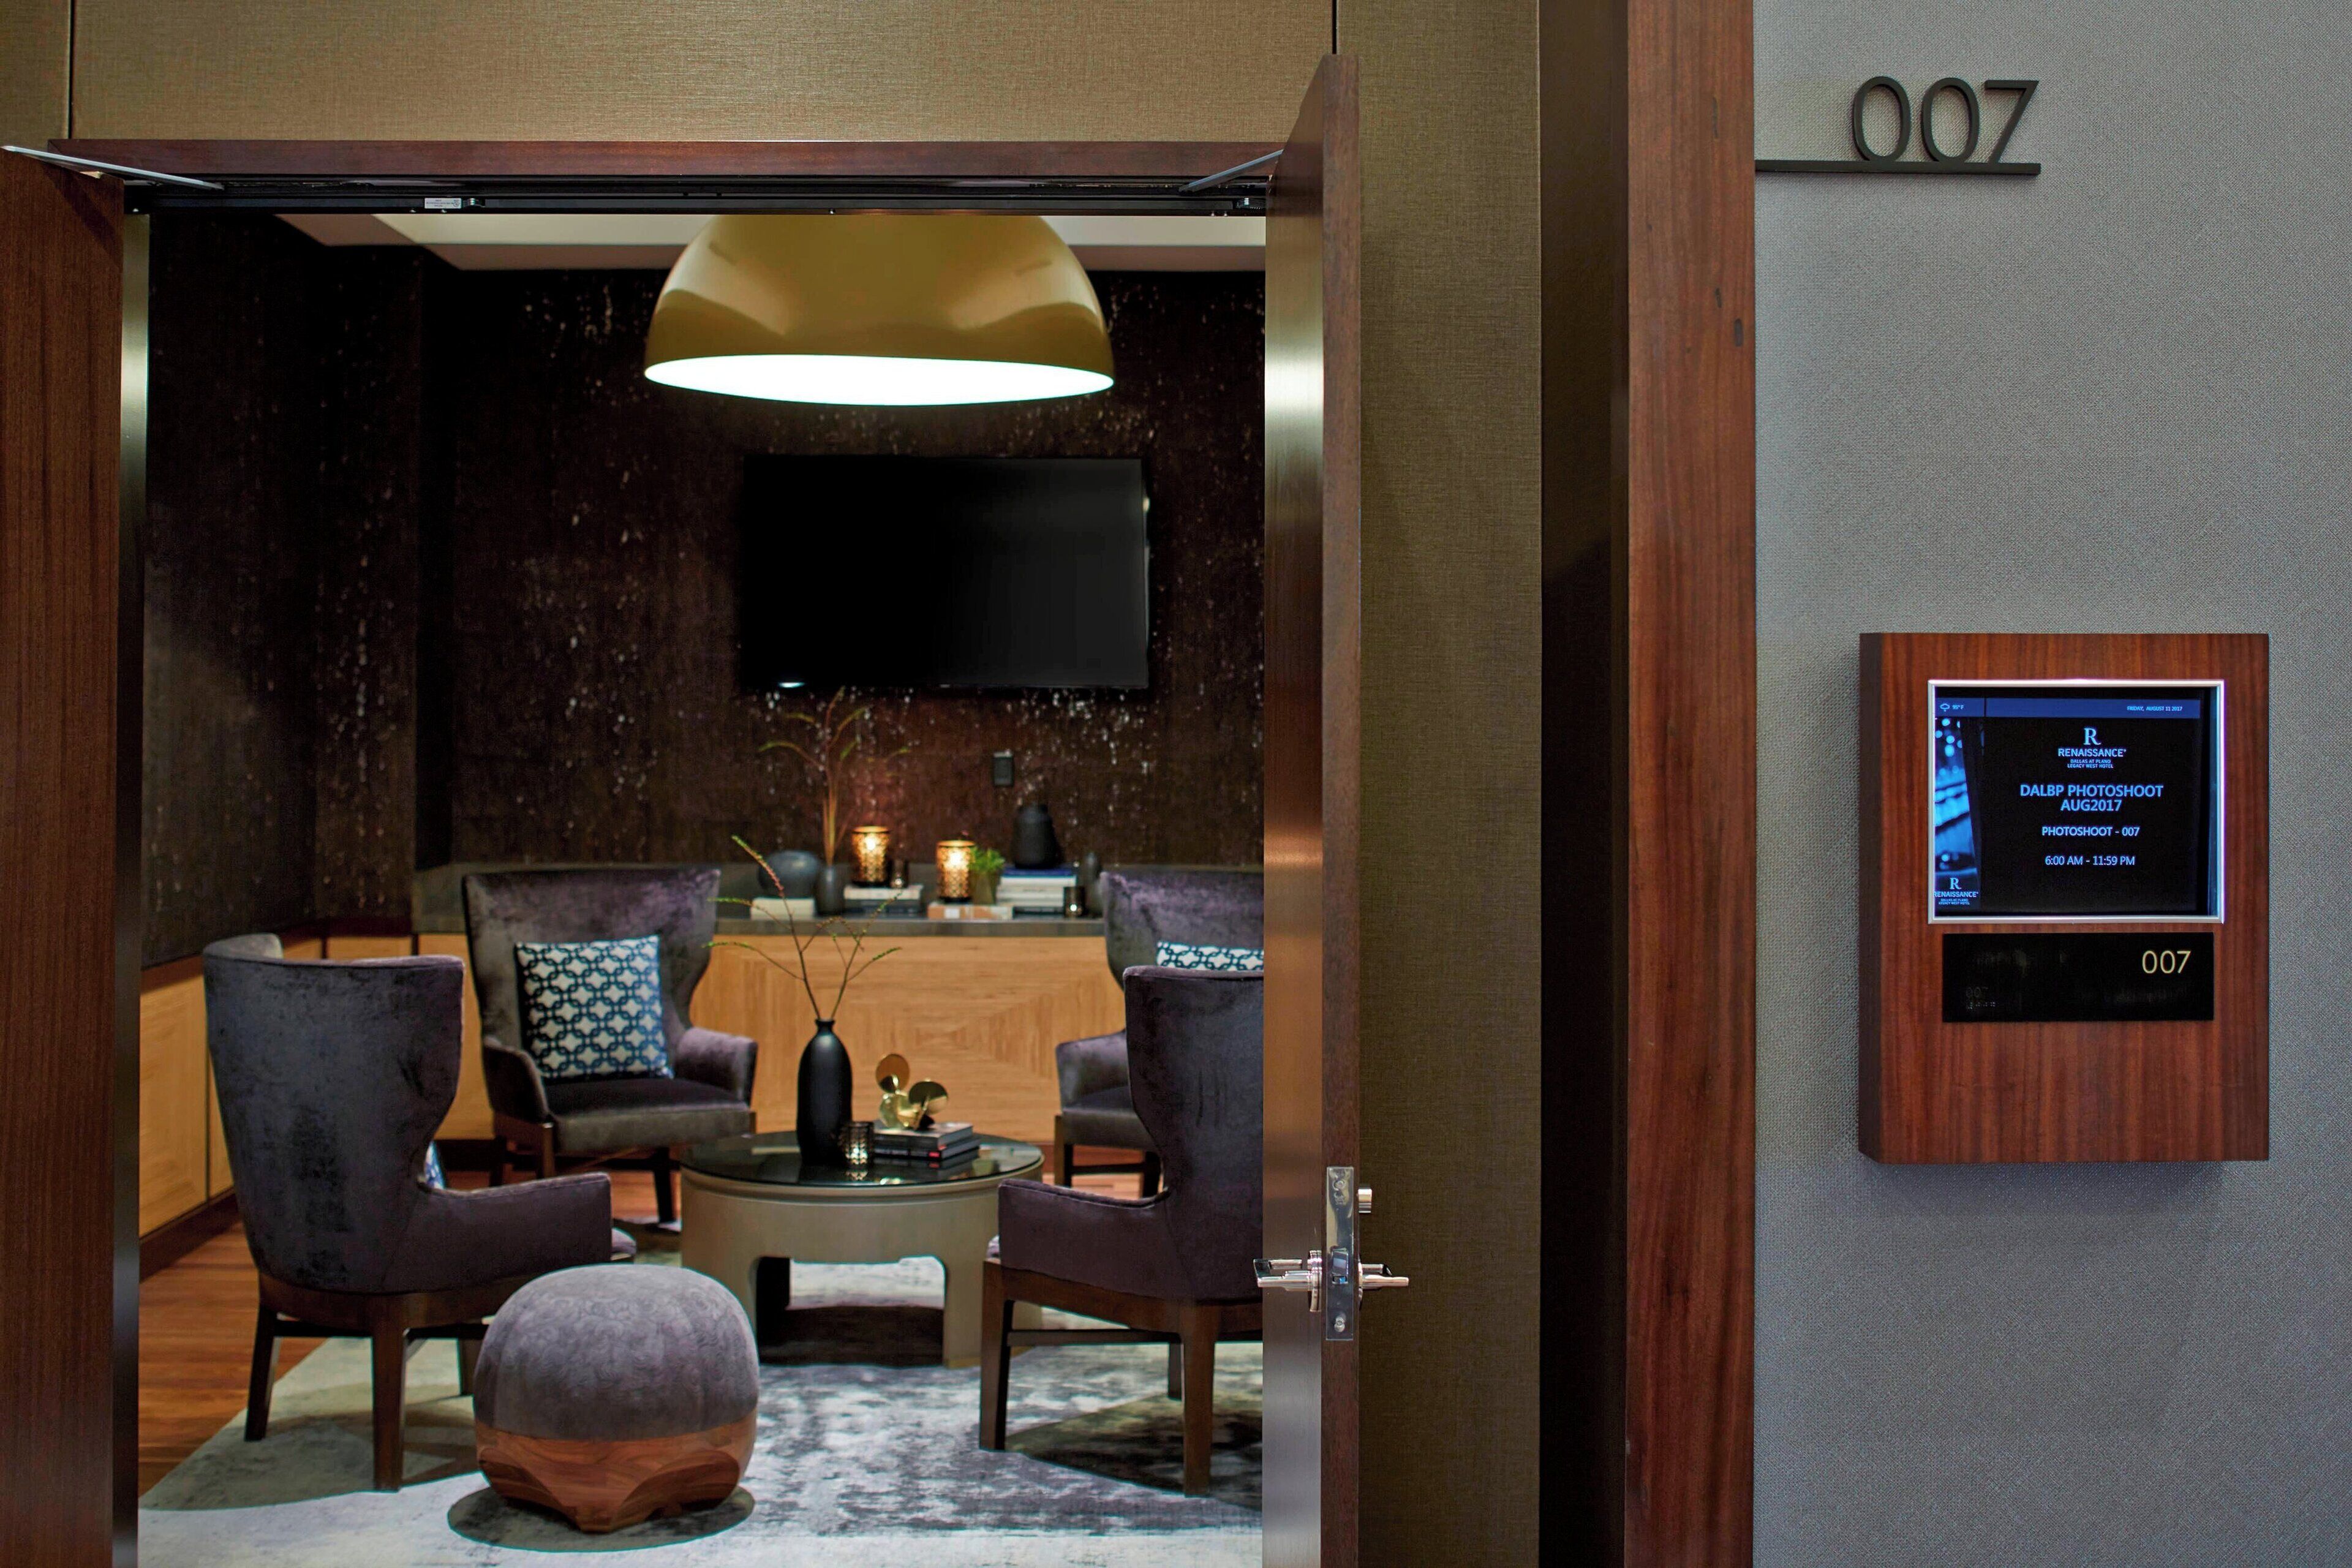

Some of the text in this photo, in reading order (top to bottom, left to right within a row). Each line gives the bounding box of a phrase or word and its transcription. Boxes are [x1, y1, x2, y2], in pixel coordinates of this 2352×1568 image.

[1853, 76, 2040, 164] 007
[2084, 727, 2101, 745] R
[2020, 784, 2164, 797] DALBP PHOTOSHOOT
[2060, 799, 2122, 812] AUG2017
[2041, 826, 2113, 837] PHOTOSHOOT
[2122, 827, 2140, 837] 007
[2045, 856, 2065, 865] 6:00
[2067, 856, 2084, 865] AM
[2093, 856, 2118, 866] 11:59
[2120, 856, 2135, 865] PM
[1950, 877, 1962, 890] R
[2142, 951, 2191, 974] 007
